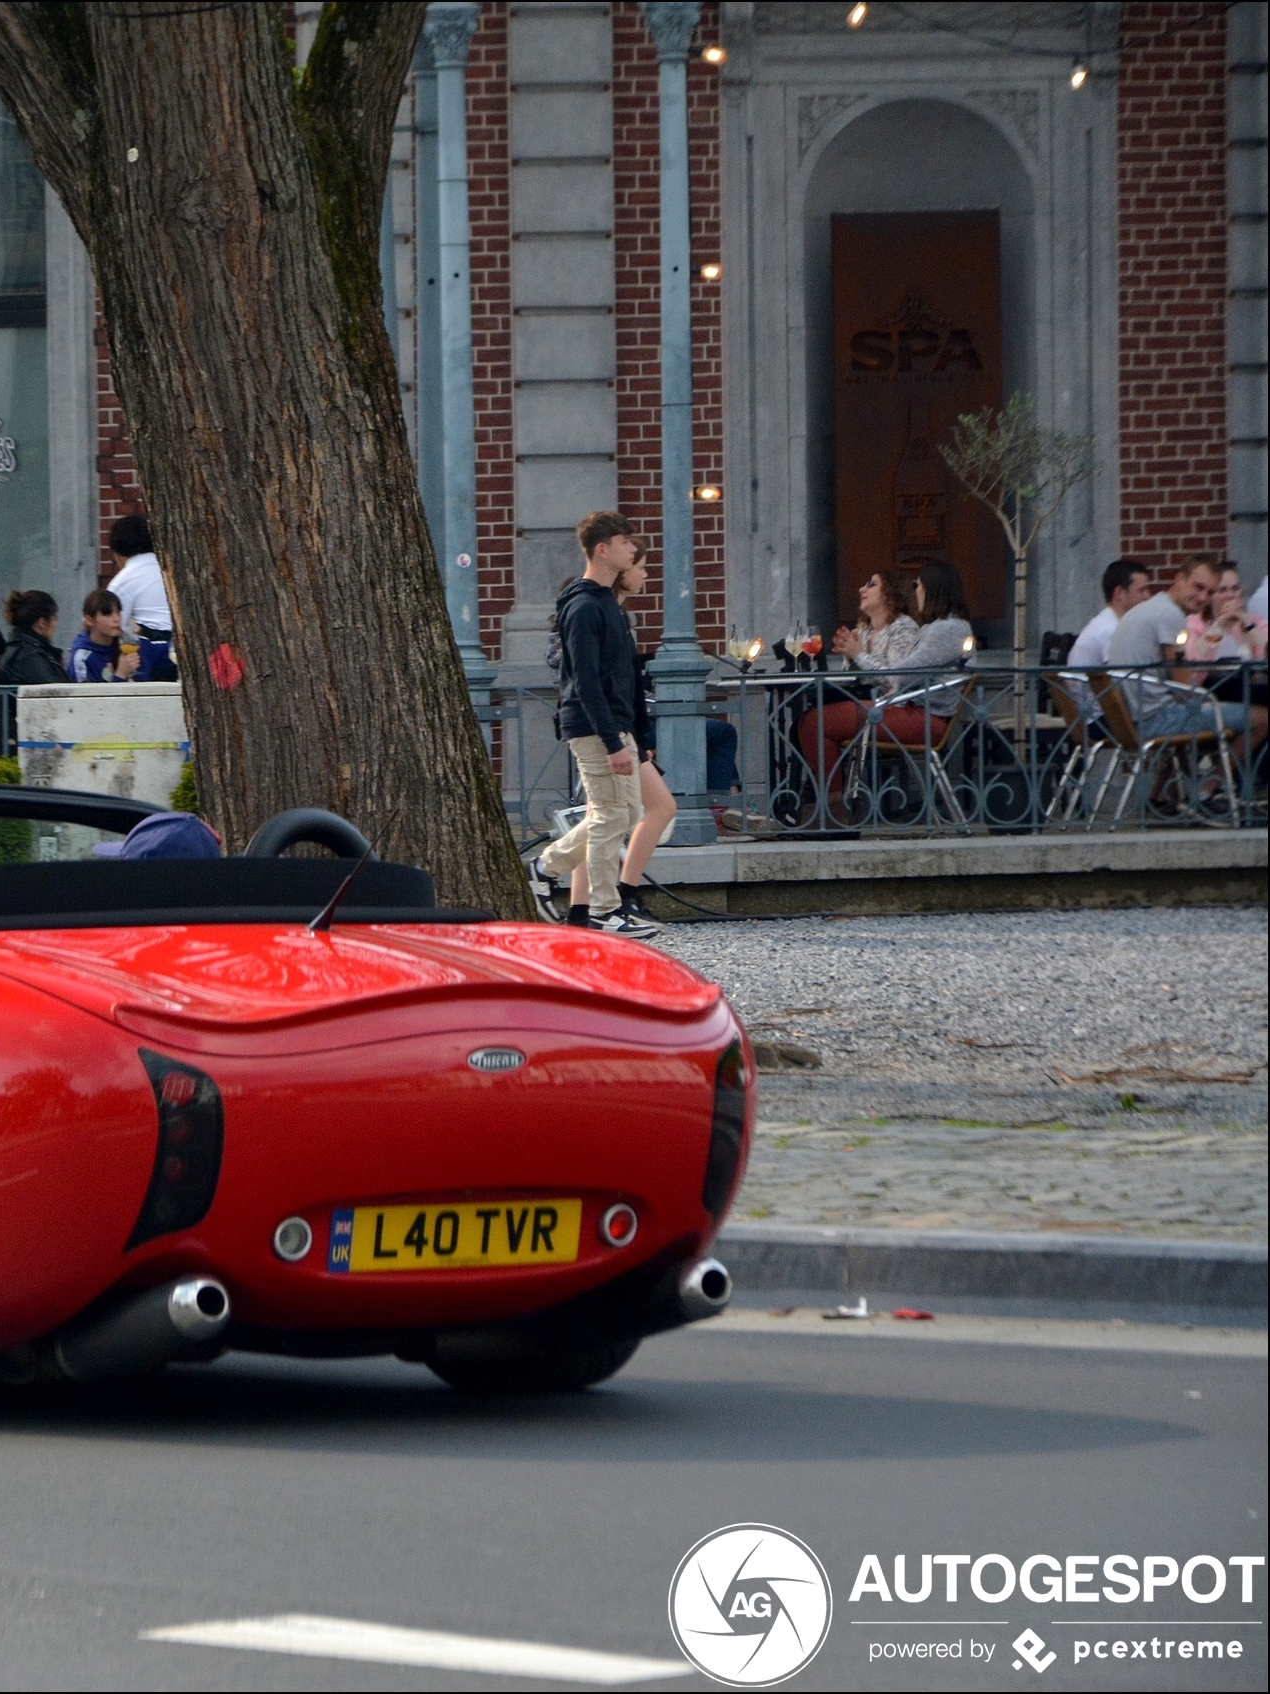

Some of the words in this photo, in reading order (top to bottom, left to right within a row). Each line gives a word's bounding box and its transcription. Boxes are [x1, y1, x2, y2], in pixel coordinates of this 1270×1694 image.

[850, 329, 983, 372] SPA
[902, 498, 936, 509] SPA
[372, 1210, 460, 1259] L40
[477, 1206, 558, 1253] TVR
[332, 1244, 350, 1263] UK
